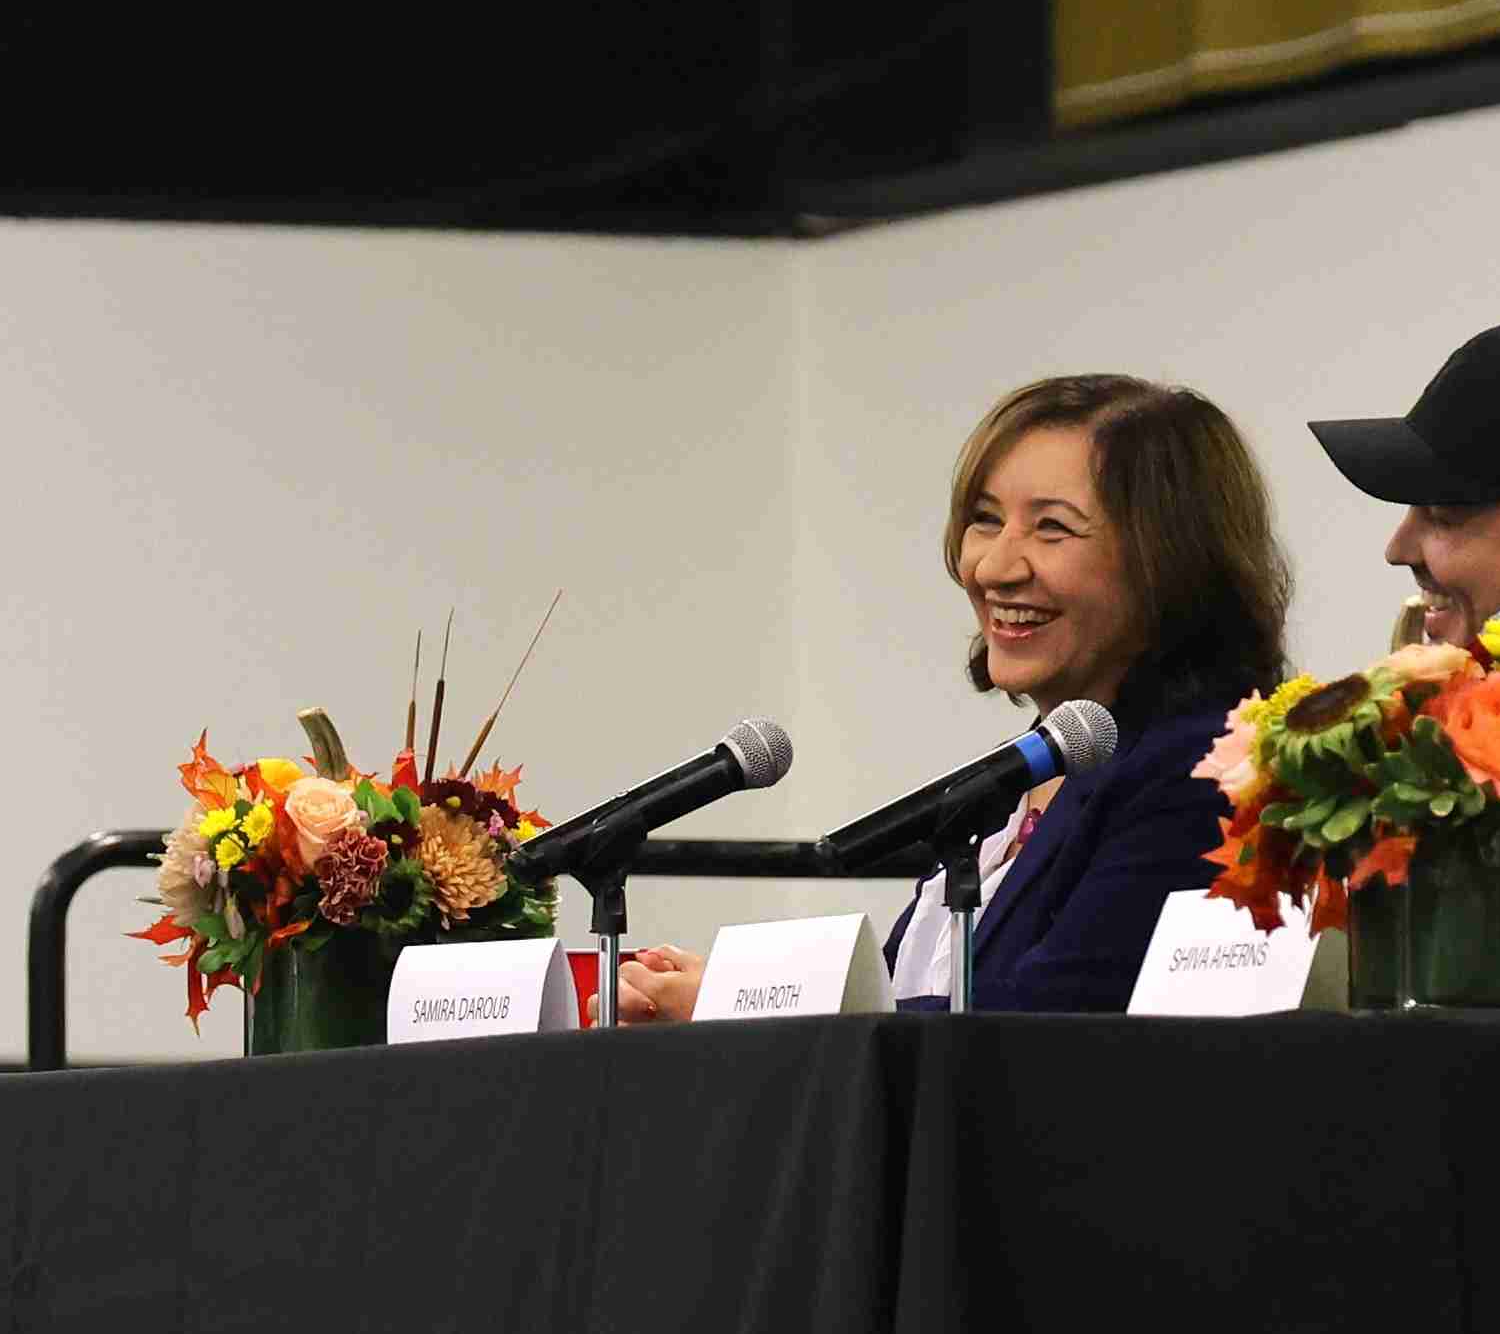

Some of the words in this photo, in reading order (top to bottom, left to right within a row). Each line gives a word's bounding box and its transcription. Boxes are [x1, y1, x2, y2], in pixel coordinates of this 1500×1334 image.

[1167, 946, 1211, 973] SHIVA
[411, 997, 457, 1024] SAMIRA
[457, 995, 511, 1022] DAROUB
[733, 986, 767, 1013] RYAN
[767, 982, 803, 1011] ROTH
